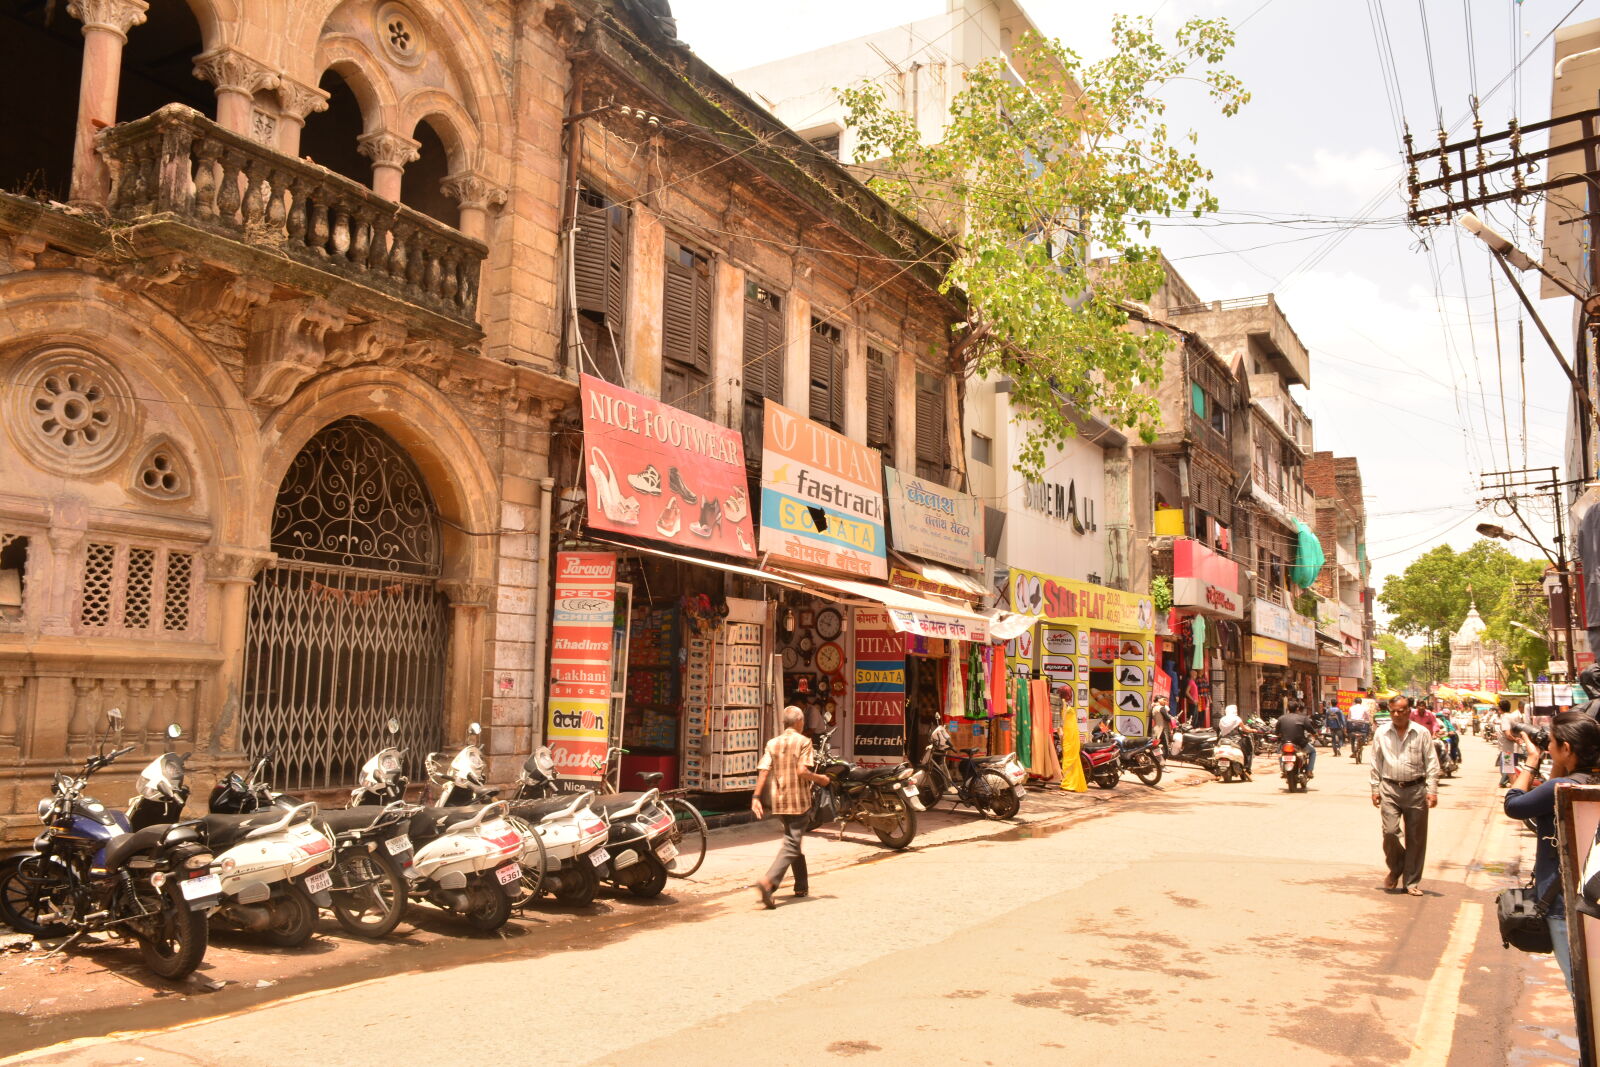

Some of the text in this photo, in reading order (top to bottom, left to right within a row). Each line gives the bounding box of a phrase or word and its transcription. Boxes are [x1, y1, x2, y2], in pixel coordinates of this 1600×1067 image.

[589, 389, 742, 467] NICE FOOTWEAR
[805, 423, 877, 487] TITAN
[797, 469, 882, 521] fastrack
[785, 536, 830, 565] कोमल
[562, 557, 613, 577] Paragon
[560, 590, 612, 598] RED
[1080, 590, 1105, 620] FLAT
[557, 614, 614, 622] CHIEF
[856, 610, 878, 624] कोमल
[919, 614, 946, 635] कोमल
[555, 638, 609, 651] Khadim's
[857, 637, 903, 653] TITAN
[556, 669, 606, 683] Lakhani
[858, 671, 902, 682] SONATA
[555, 688, 606, 696] SHOES
[857, 701, 901, 717] TITAN
[855, 735, 903, 746] fastrack
[553, 747, 602, 768] Bata
[564, 782, 586, 792] Nice
